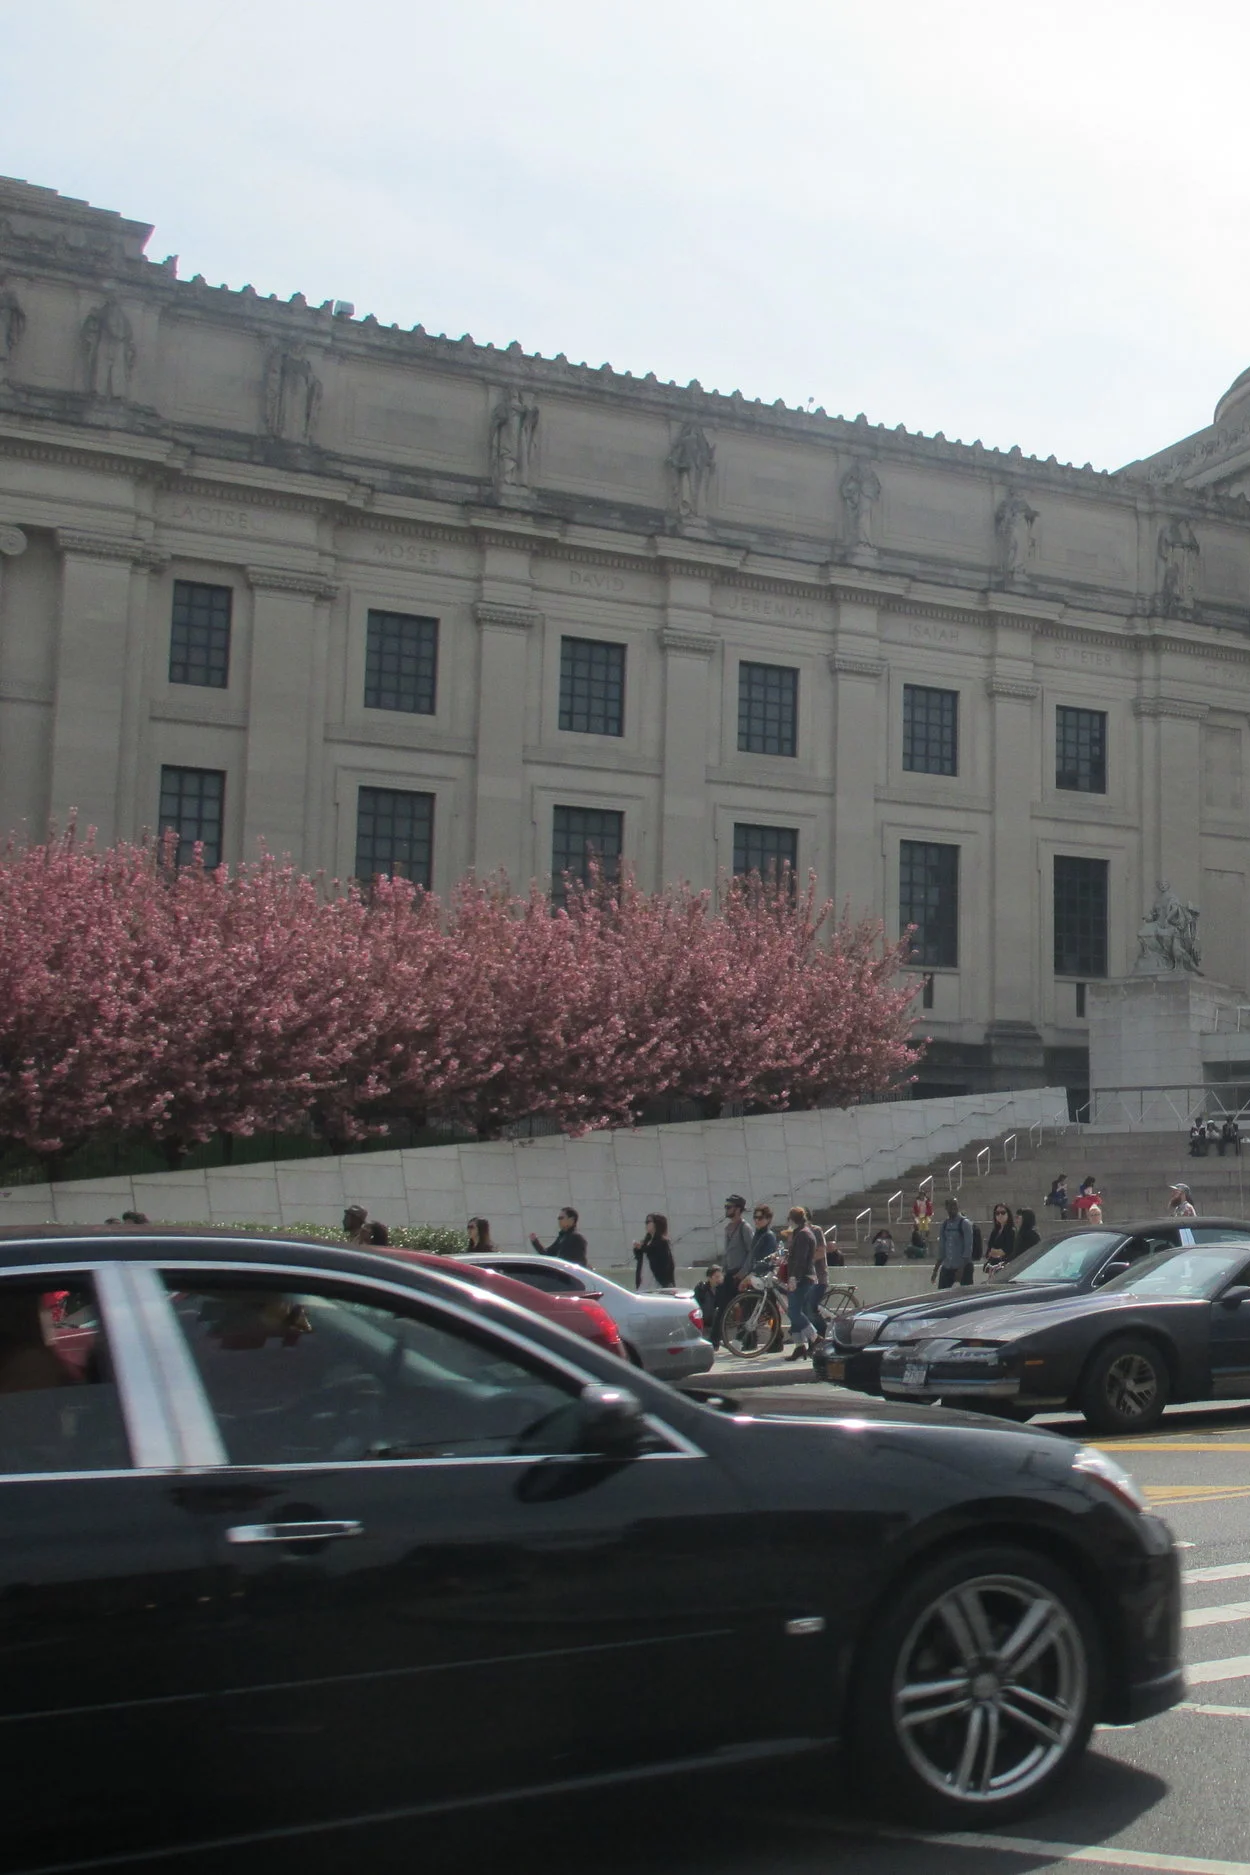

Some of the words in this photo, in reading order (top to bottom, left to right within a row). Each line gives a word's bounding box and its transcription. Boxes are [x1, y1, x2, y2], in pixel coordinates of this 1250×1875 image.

[372, 542, 440, 565] MOSES
[569, 570, 625, 592] DAVID
[728, 595, 814, 619] JEREMIAH
[907, 623, 960, 643] ISAIAH
